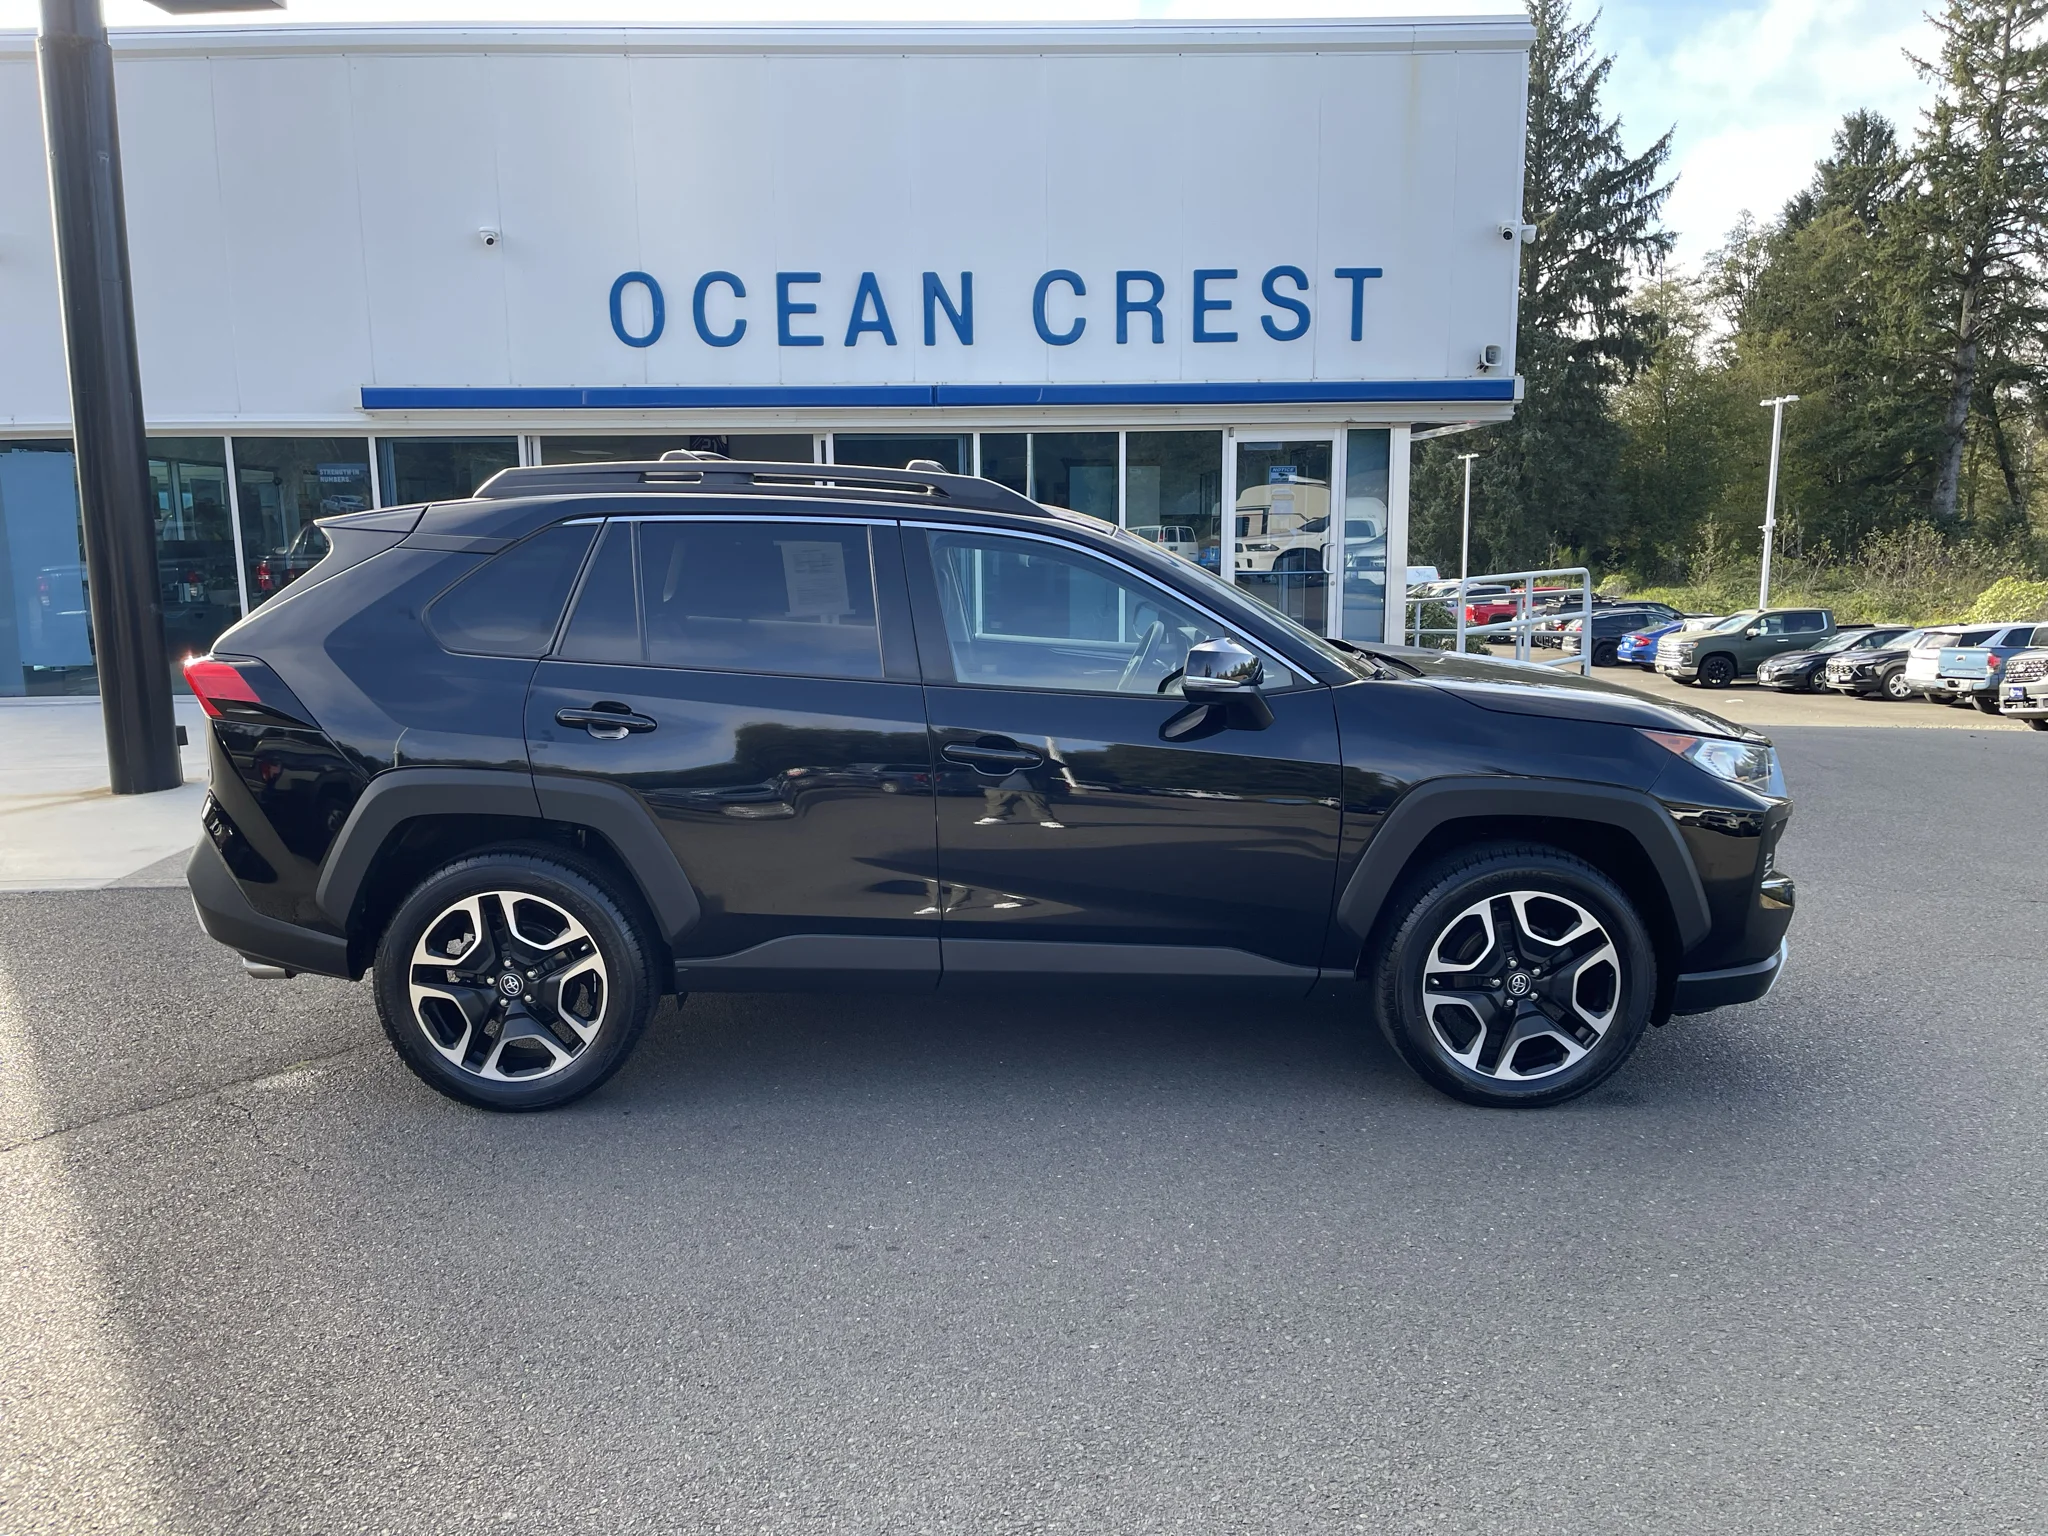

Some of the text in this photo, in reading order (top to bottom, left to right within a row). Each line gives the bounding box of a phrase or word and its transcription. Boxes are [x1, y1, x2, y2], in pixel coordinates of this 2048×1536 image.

[609, 265, 1383, 347] OCEAN CREST
[319, 468, 352, 476] STRENGTH
